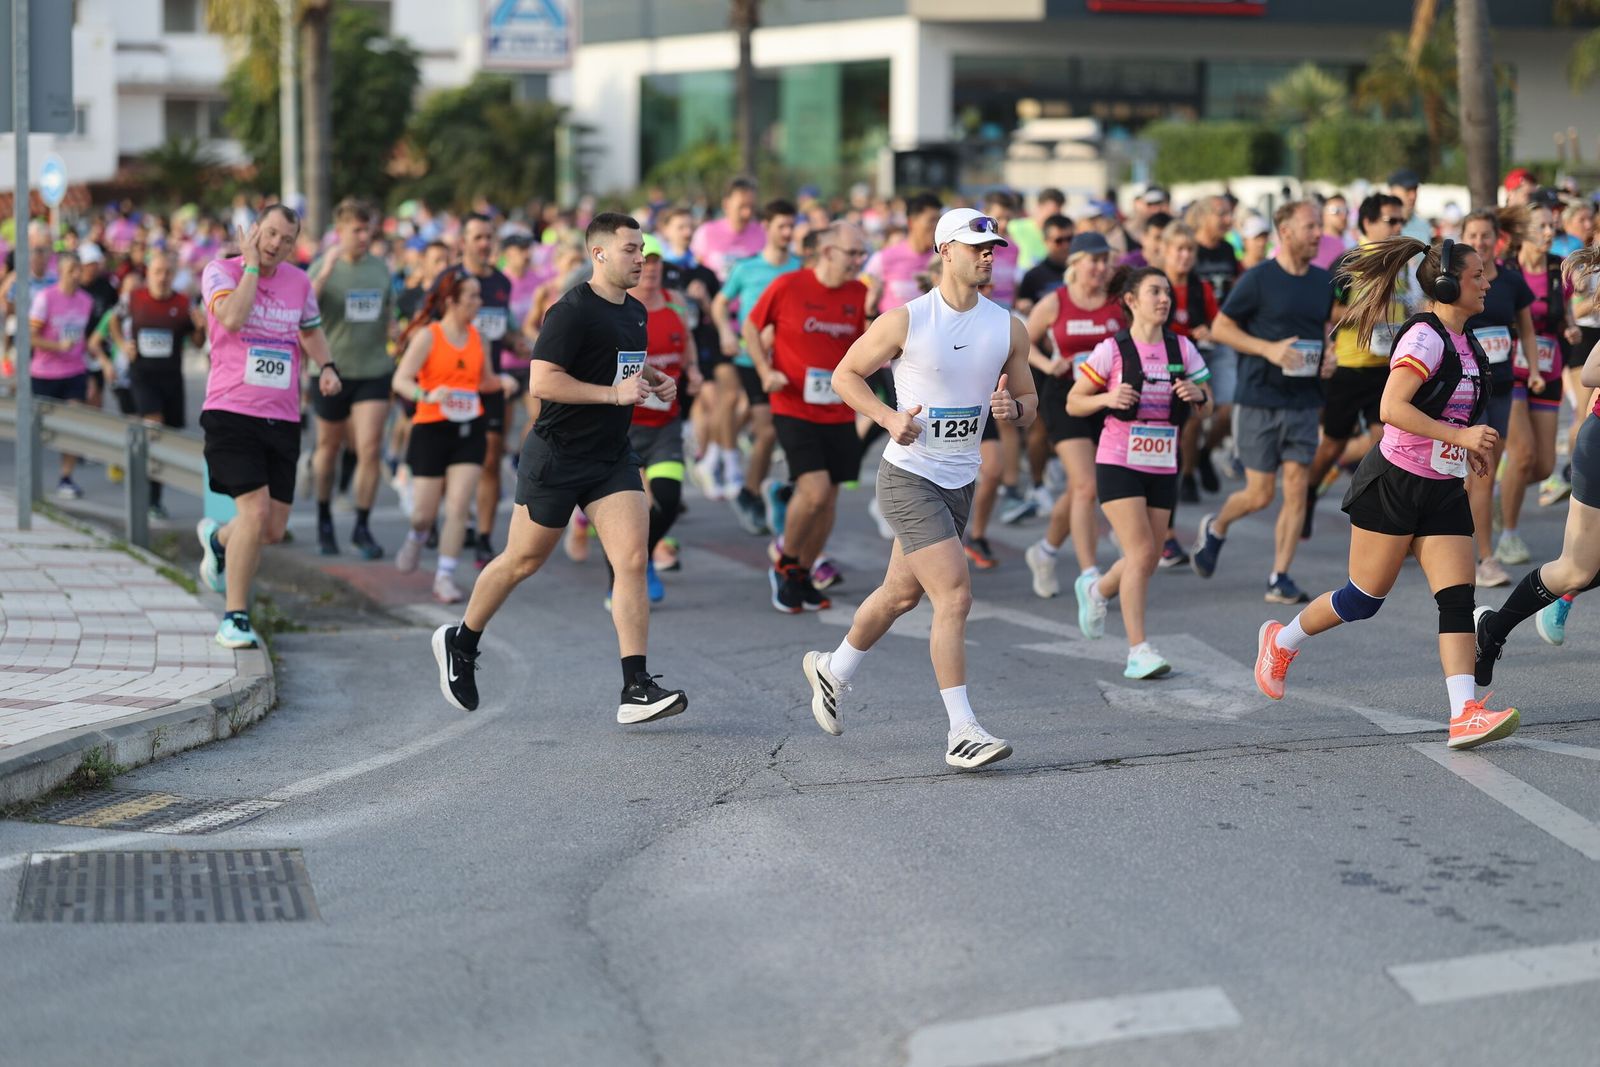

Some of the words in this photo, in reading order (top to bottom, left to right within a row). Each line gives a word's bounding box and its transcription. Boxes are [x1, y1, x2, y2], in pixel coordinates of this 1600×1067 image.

[255, 358, 285, 376] 209
[931, 417, 979, 438] 1234
[1131, 437, 1172, 453] 2001
